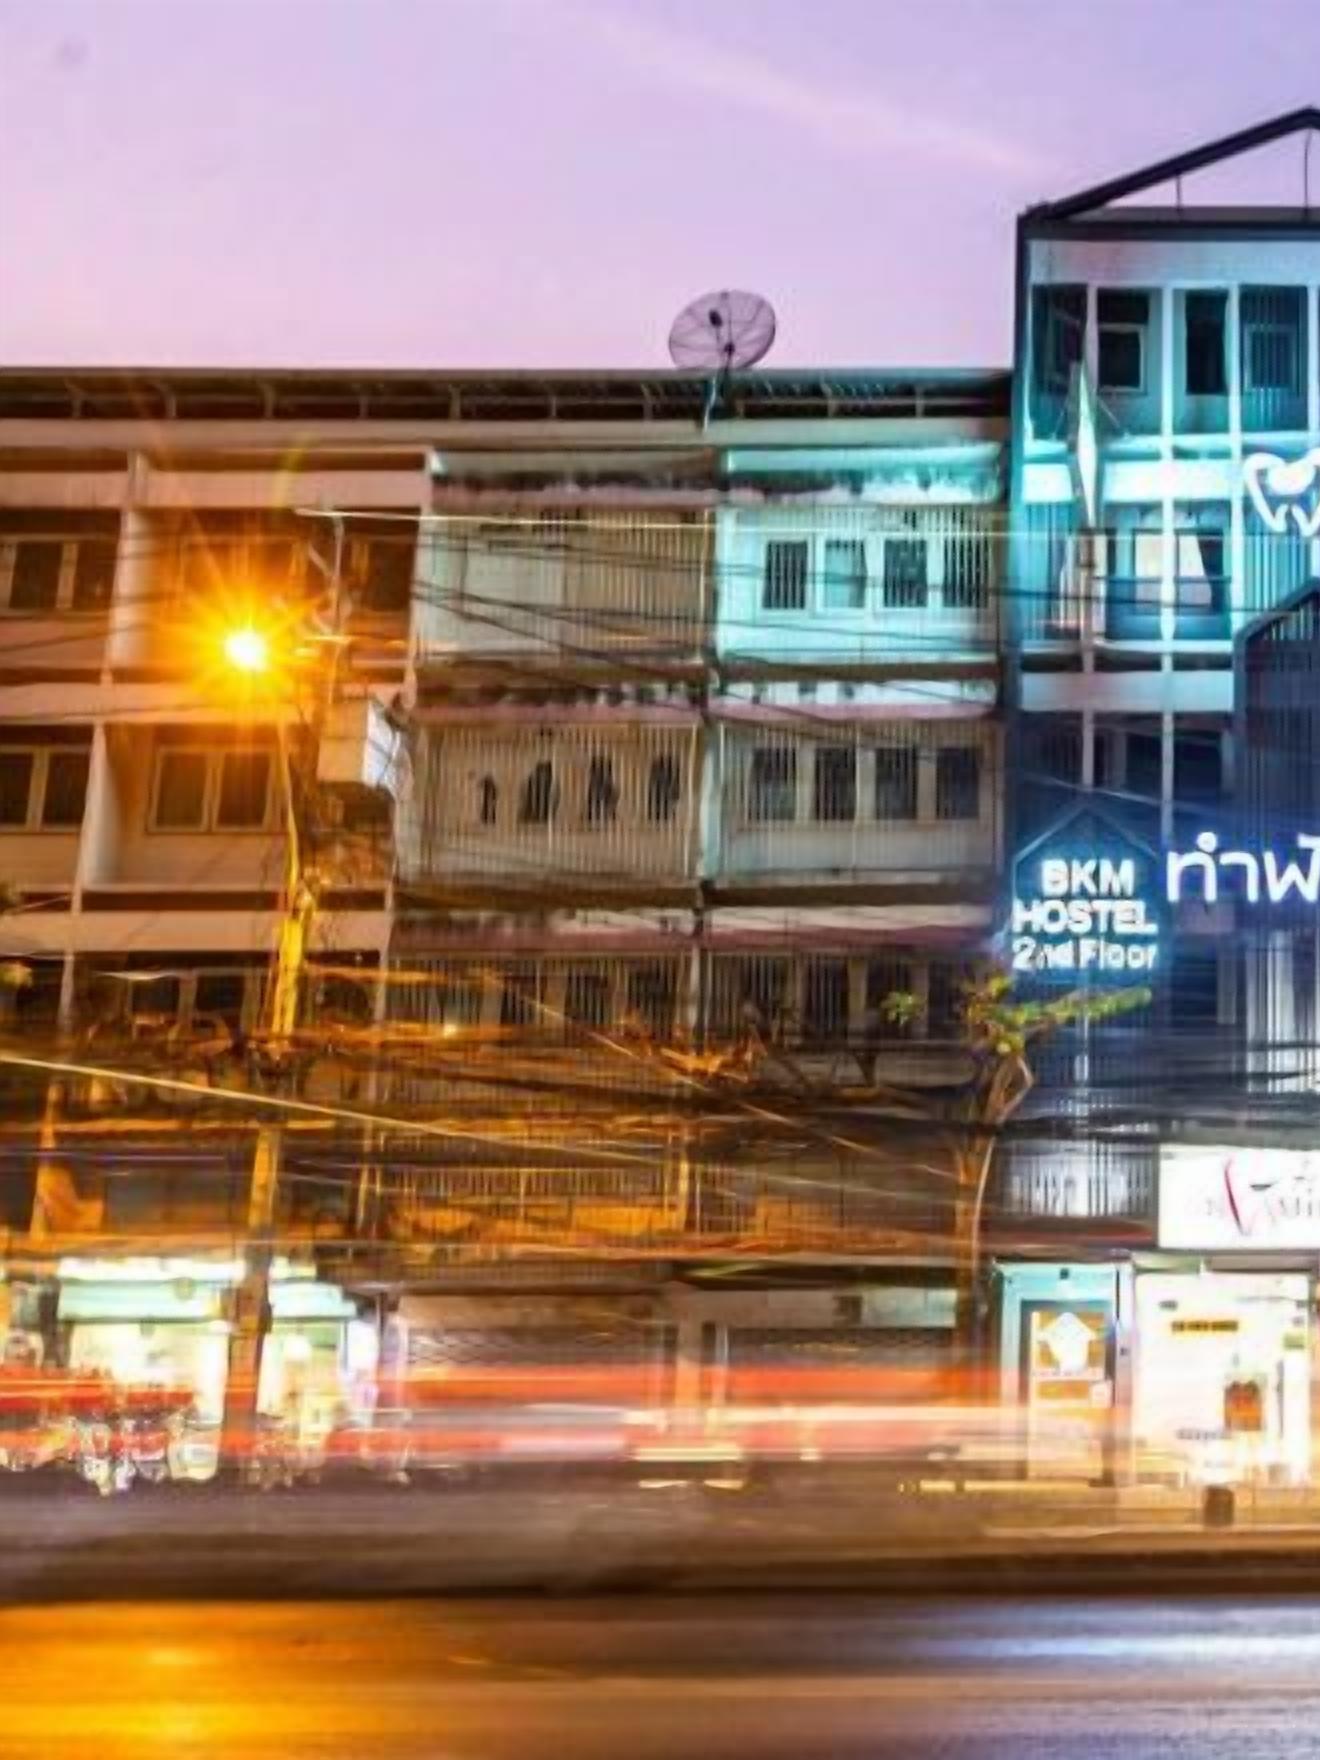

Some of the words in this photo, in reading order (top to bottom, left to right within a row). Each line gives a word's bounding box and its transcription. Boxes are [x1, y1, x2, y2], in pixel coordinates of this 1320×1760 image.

[1042, 858, 1134, 897] BKM
[1012, 899, 1159, 934] HOSTEL
[1012, 936, 1075, 970] 2nd
[1079, 937, 1158, 970] Floor
